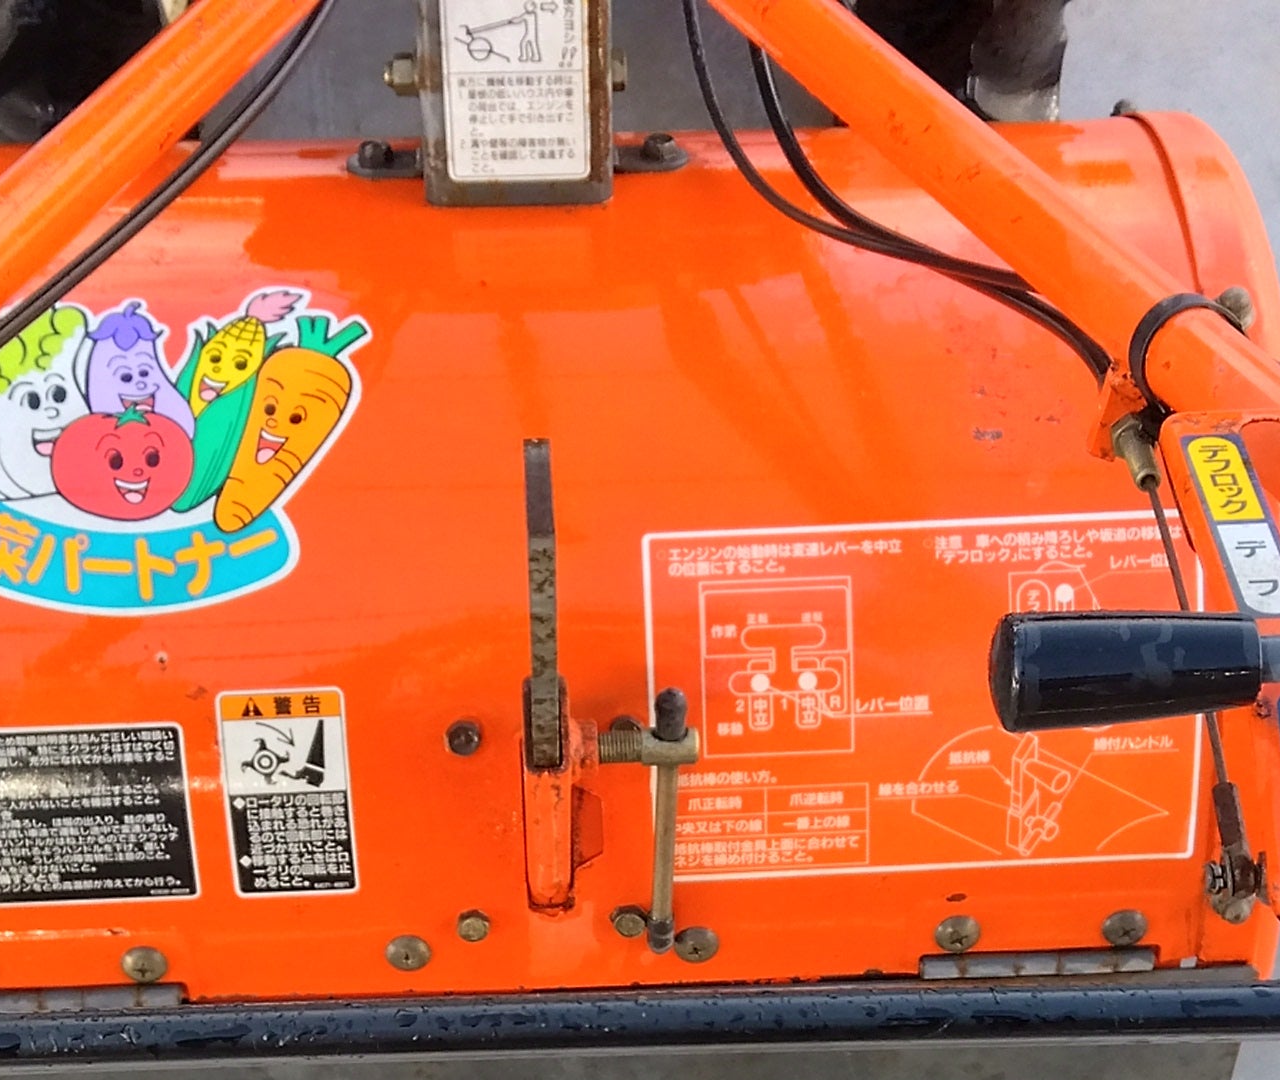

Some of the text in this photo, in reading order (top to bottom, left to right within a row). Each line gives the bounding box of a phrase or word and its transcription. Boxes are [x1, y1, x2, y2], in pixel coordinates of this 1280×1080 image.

[1197, 443, 1250, 516] デフロック
[668, 559, 787, 577] の位置にすること。
[1109, 553, 1171, 569] レバー位
[1233, 538, 1280, 597] デフ
[273, 695, 320, 716] 警告
[736, 698, 745, 713] 2
